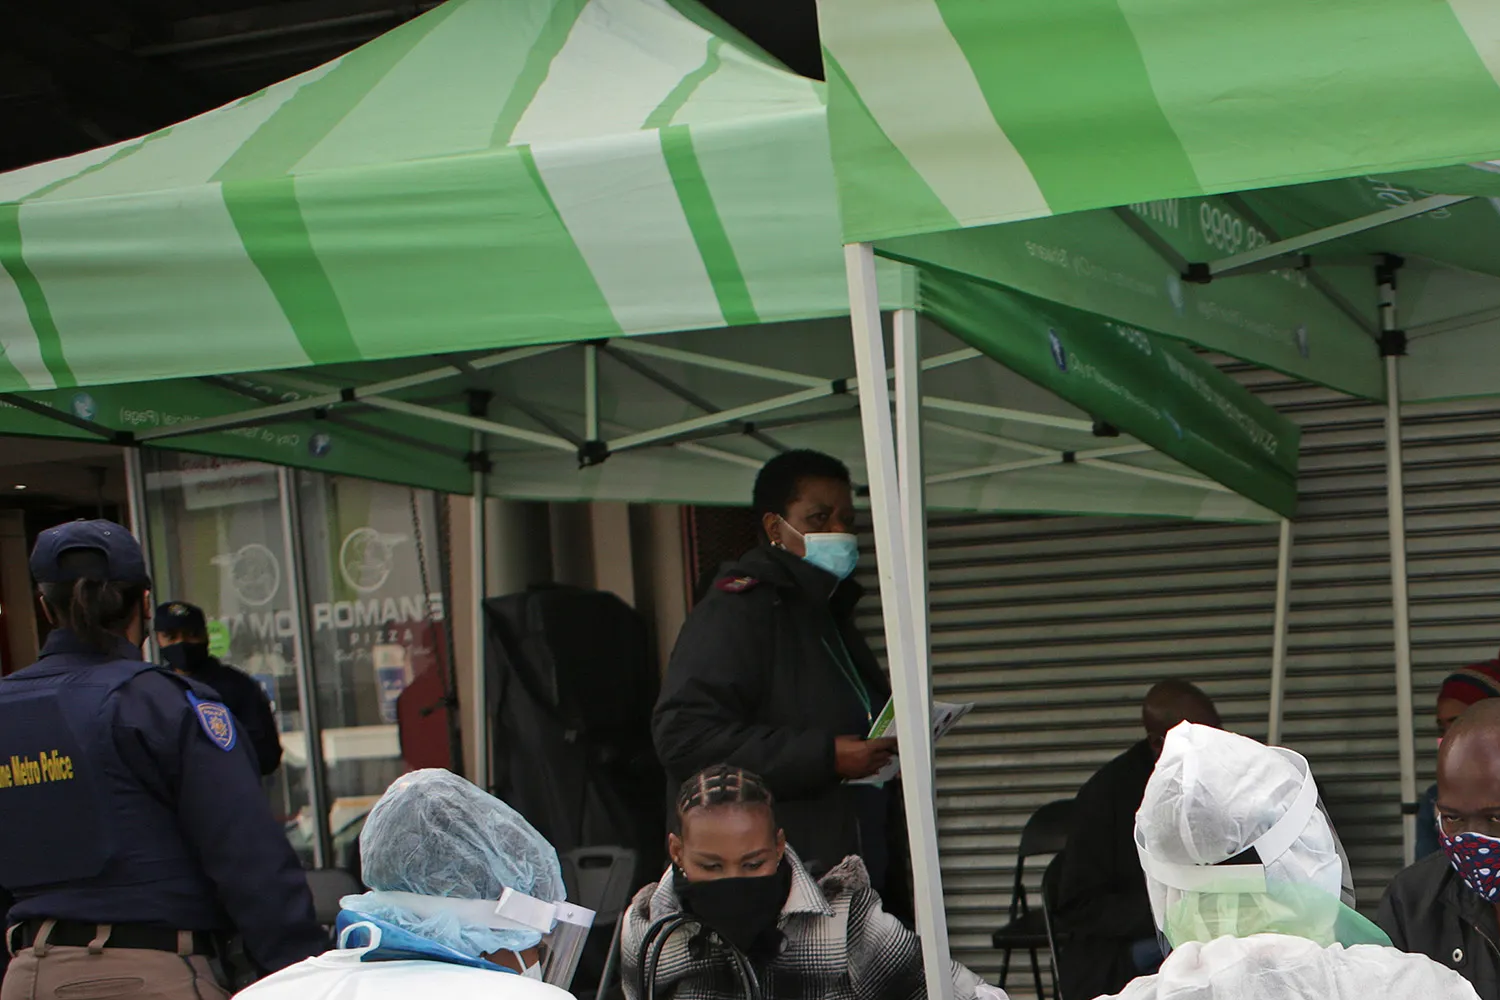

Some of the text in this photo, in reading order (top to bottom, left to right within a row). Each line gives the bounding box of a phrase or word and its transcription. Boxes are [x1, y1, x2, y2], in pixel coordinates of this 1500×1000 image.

[350, 628, 415, 647] PIZZA
[10, 755, 40, 787] Metro
[39, 749, 74, 783] Police
